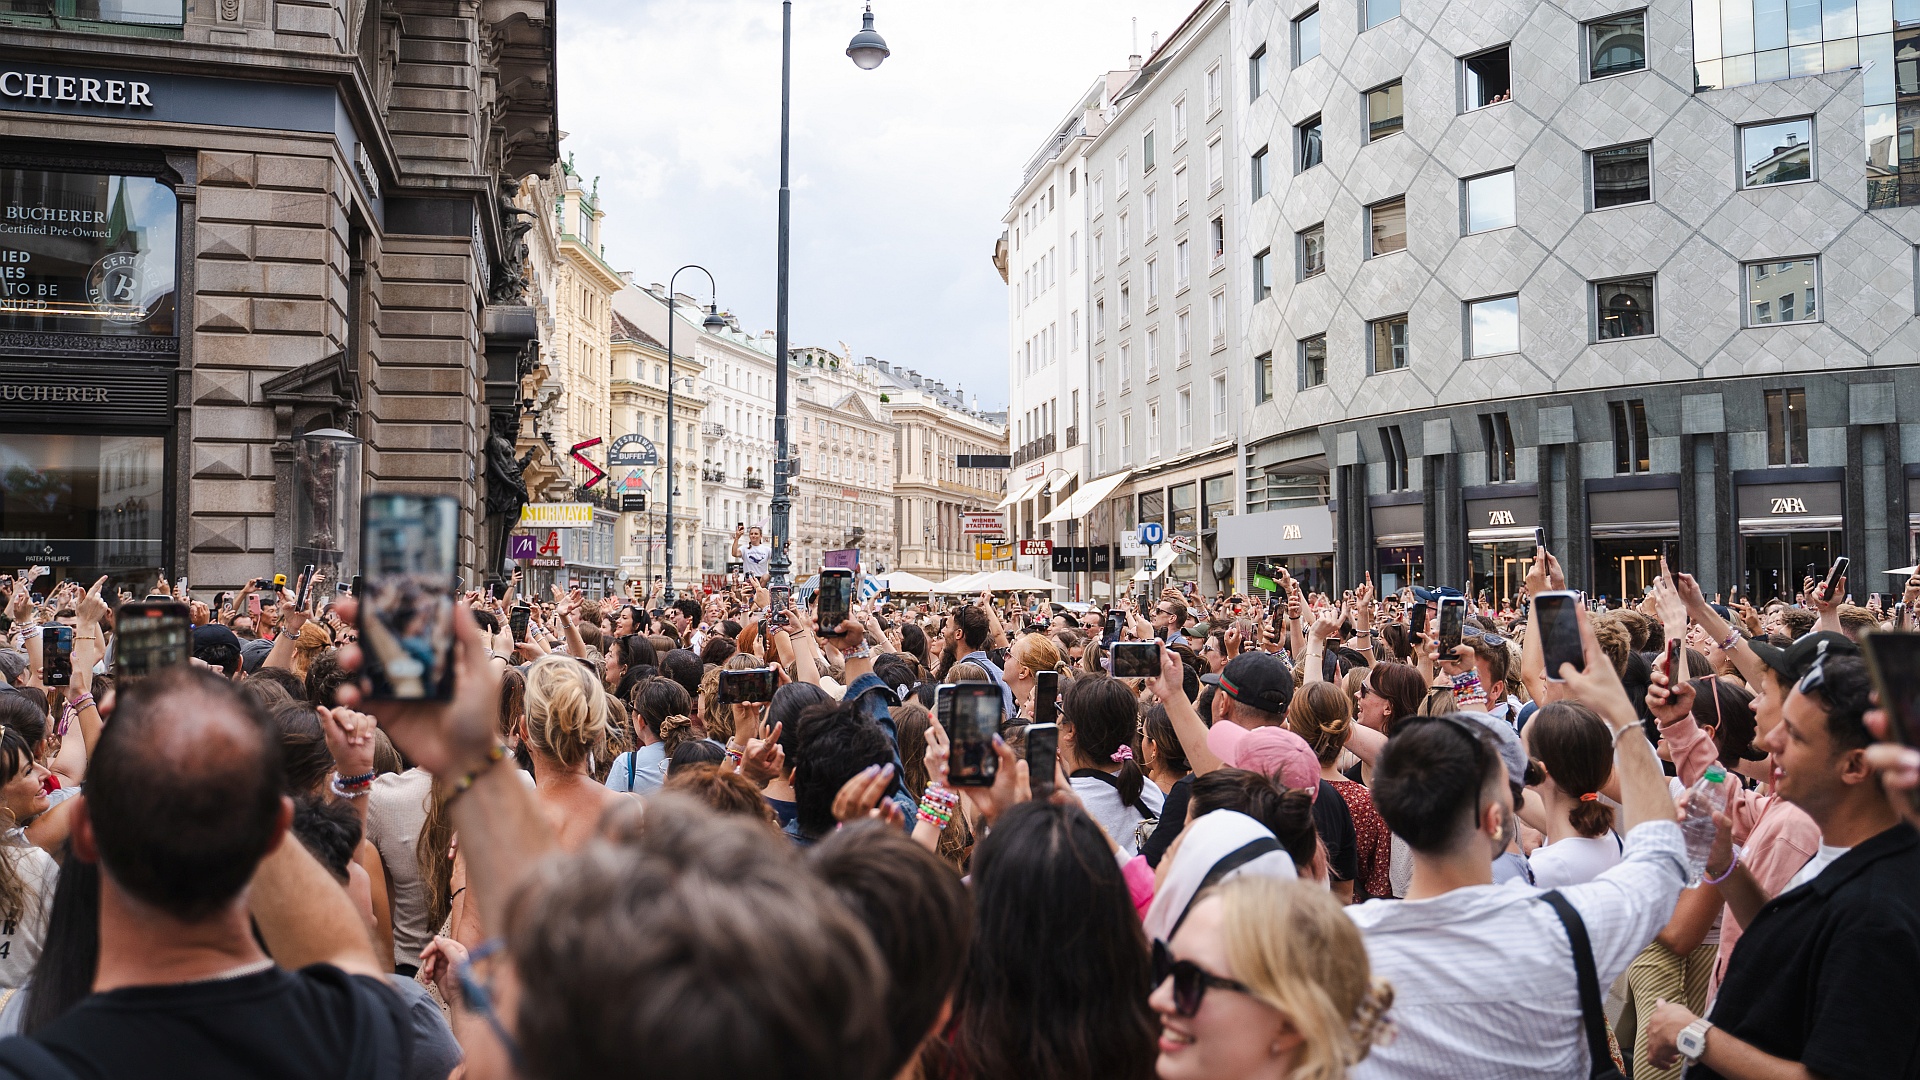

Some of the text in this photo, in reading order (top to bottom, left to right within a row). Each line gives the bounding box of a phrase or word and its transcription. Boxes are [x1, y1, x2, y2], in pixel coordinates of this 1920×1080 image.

[6, 206, 106, 224] BUCHERER
[0, 223, 112, 238] Certified Pre-Owned
[7, 282, 58, 296] TO BE
[618, 452, 647, 460] BUFFET
[525, 505, 589, 521] STURMAYR
[1770, 497, 1809, 514] ZARA
[1488, 510, 1516, 525] ZARA
[1146, 527, 1161, 542] U
[1282, 524, 1302, 540] ZARA
[1025, 547, 1048, 555] GUYS
